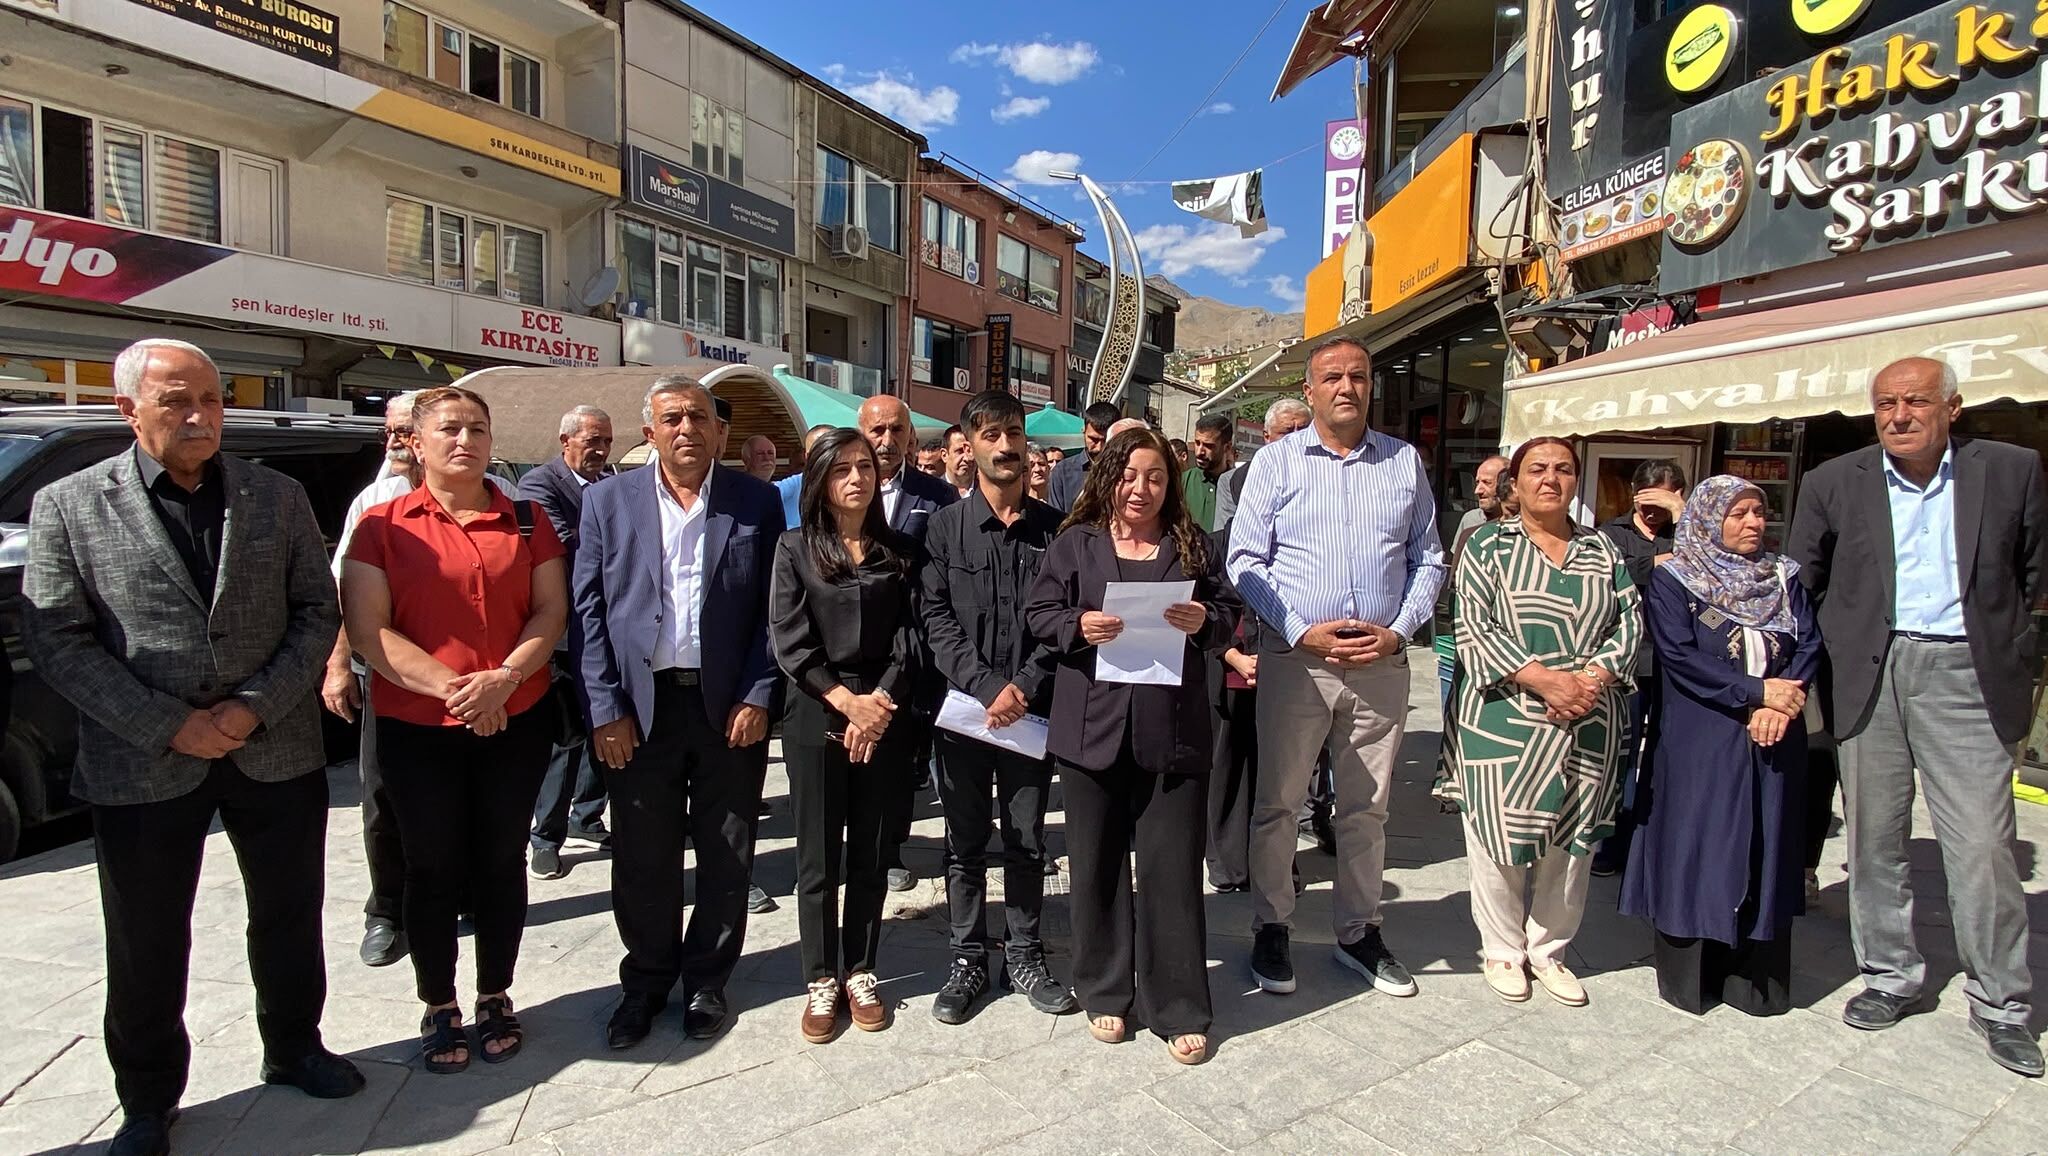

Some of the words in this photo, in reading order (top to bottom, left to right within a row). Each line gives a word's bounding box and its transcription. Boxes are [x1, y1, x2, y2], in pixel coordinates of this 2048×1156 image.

[215, 4, 270, 34] Ramazan
[272, 25, 334, 57] KURTULUŞ
[649, 175, 697, 206] Marshall
[1564, 182, 1602, 211] ELİSA
[1605, 155, 1663, 196] KÜNEFE
[0, 218, 118, 286] dyo
[231, 298, 260, 312] şen
[265, 300, 335, 324] kardeşler
[342, 312, 365, 328] ltd.
[521, 310, 564, 335] ECE
[480, 328, 600, 363] KIRTASİYE
